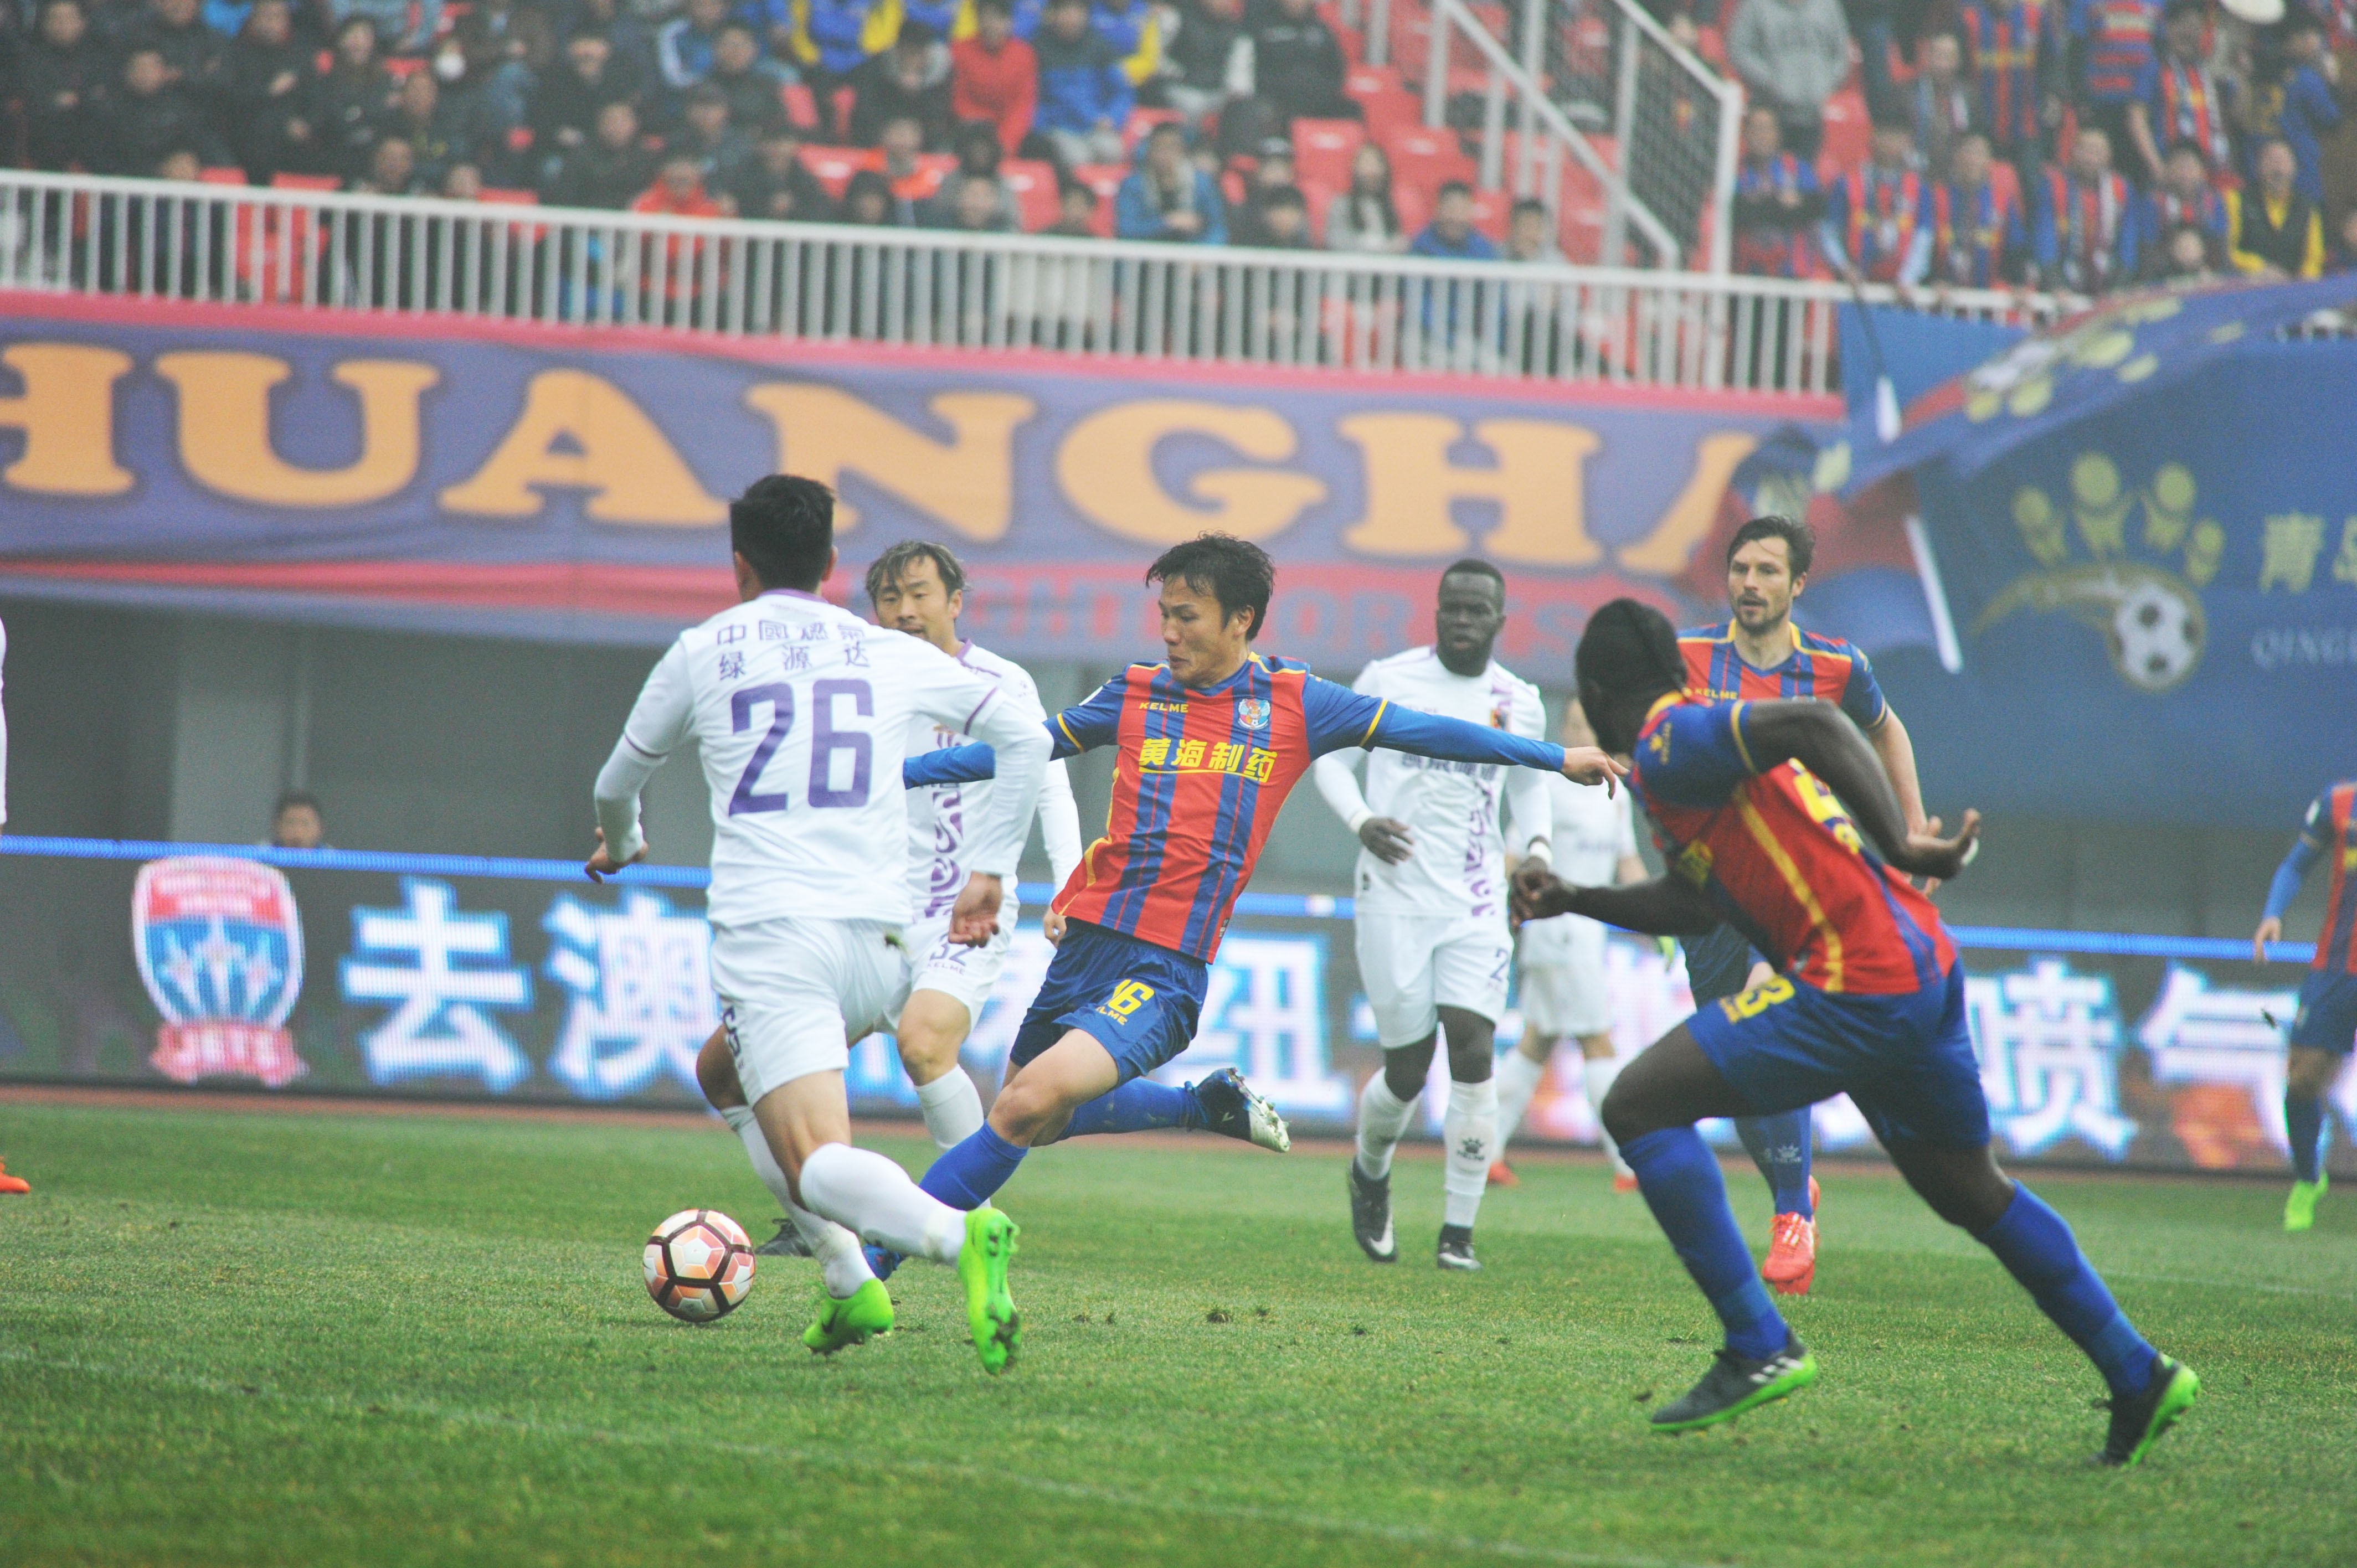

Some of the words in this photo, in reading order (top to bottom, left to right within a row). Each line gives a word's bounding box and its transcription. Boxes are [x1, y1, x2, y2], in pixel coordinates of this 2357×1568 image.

[1139, 702, 1189, 713] KELME
[1694, 688, 1738, 700] KELME
[729, 678, 874, 818] 26
[1138, 737, 1278, 783] 黄海制药
[1108, 978, 1155, 1015] 16
